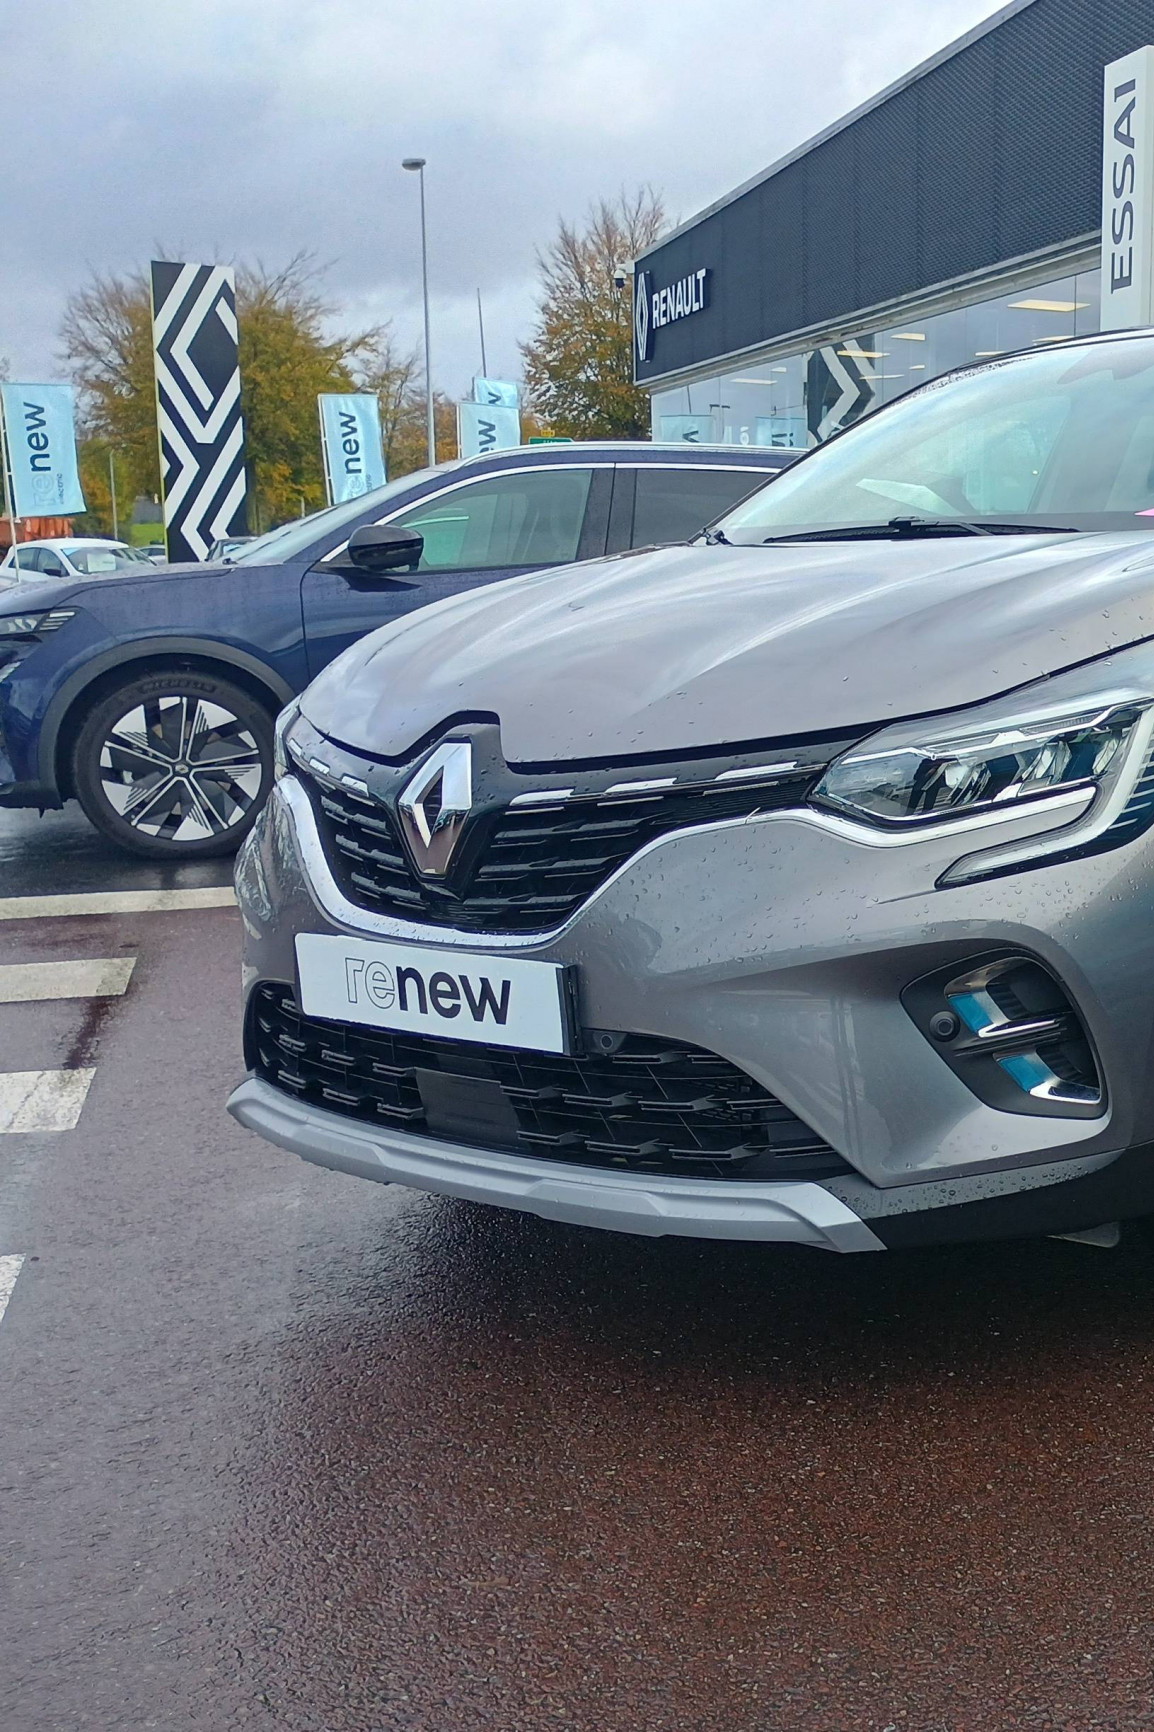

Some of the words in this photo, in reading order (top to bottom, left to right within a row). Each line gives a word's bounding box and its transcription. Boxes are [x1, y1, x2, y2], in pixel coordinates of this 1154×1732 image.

[1111, 78, 1136, 294] ESSAI
[652, 268, 706, 329] RENAULT
[23, 401, 56, 507] renew
[345, 957, 511, 1025] renew
